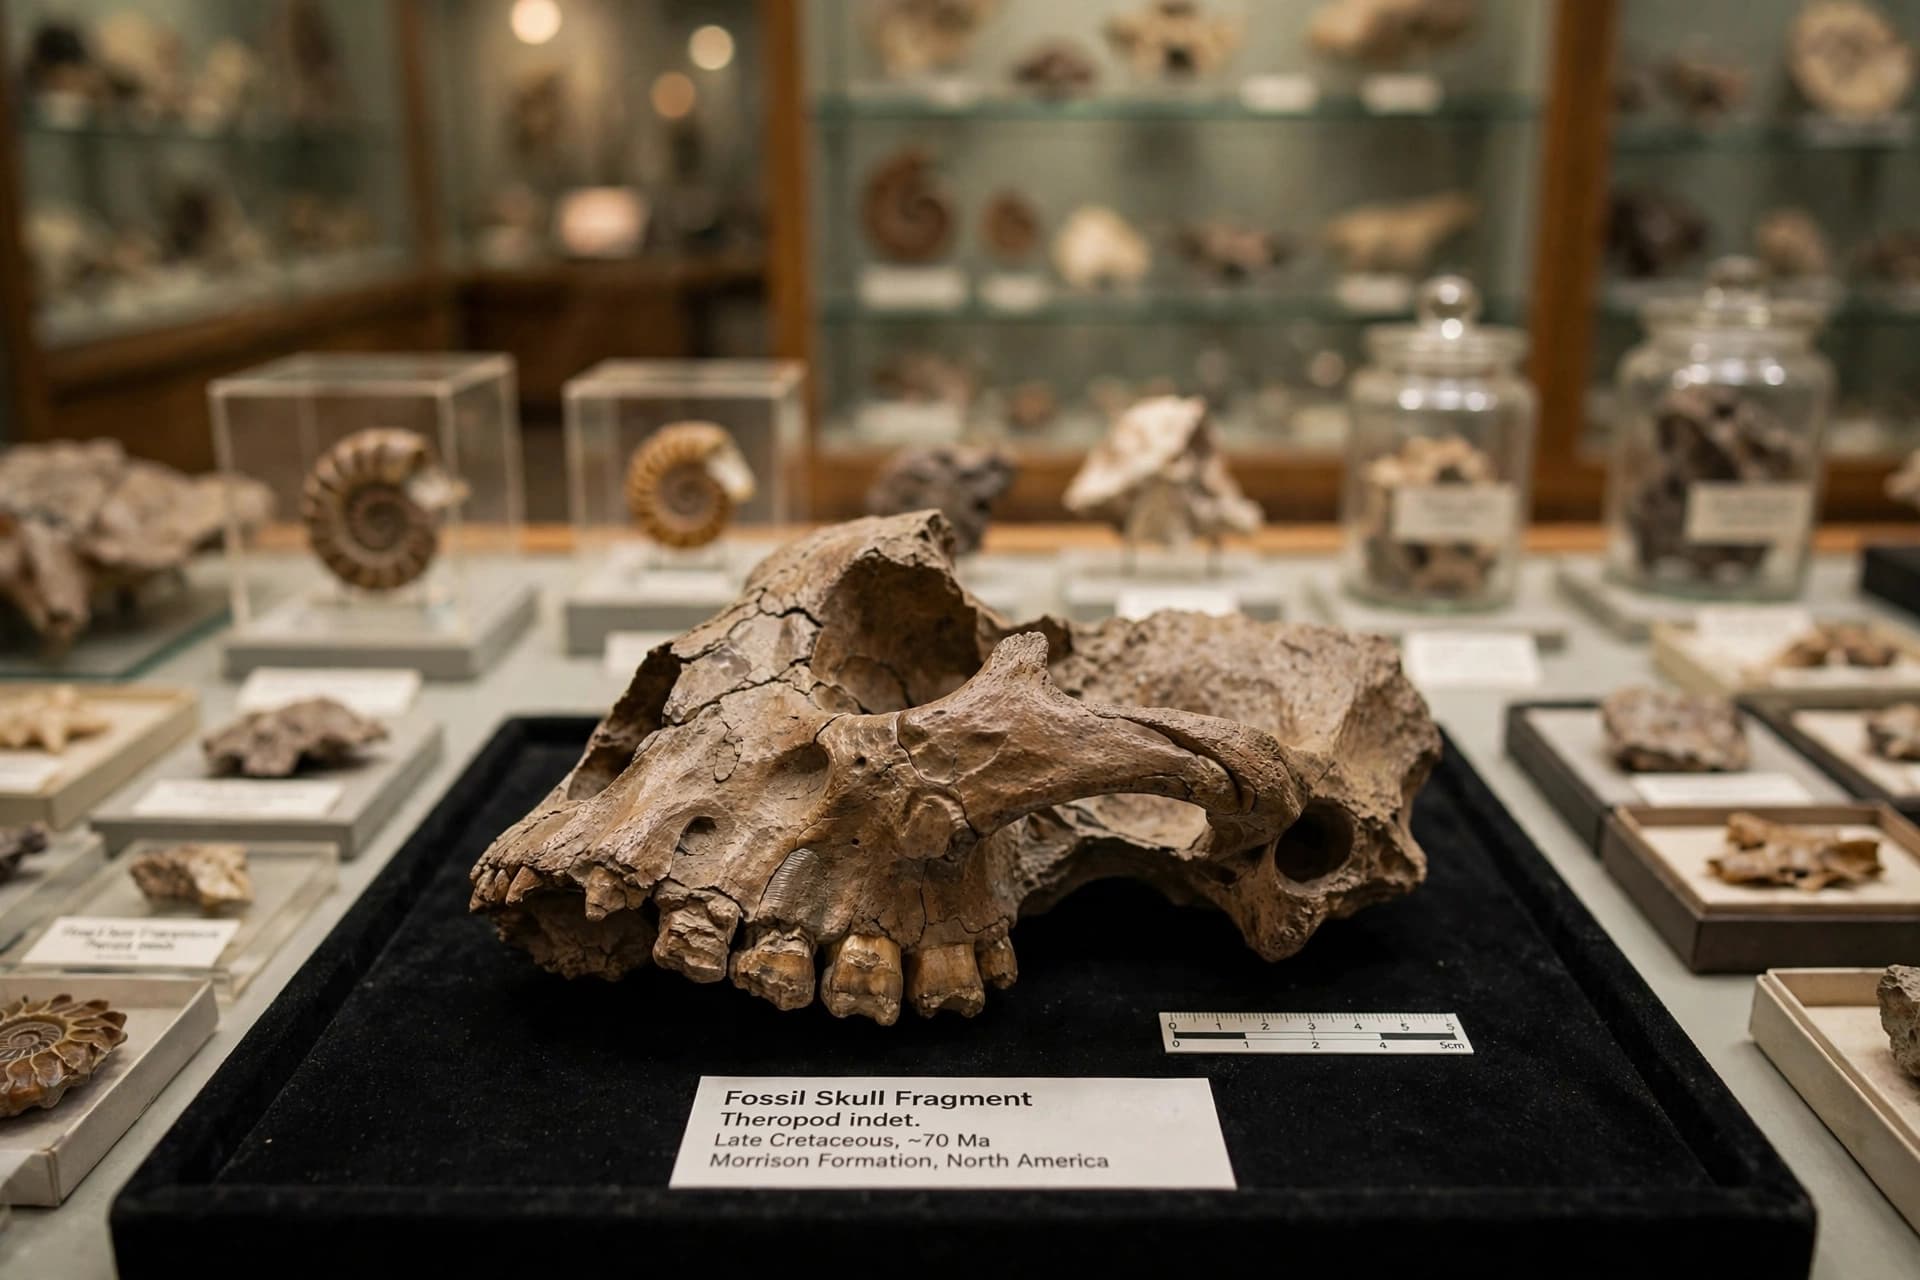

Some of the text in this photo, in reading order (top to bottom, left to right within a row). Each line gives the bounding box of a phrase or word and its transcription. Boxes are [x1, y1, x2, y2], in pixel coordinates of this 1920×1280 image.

[1168, 1022, 1455, 1031] 0 1 2 3 4 5 5
[1172, 1040, 1180, 1048] 0
[1311, 1041, 1320, 1049] 2
[1379, 1041, 1387, 1049] 4
[1439, 1041, 1465, 1049] 5cm
[724, 1090, 1033, 1110] Fossil Skull Fragment
[719, 1111, 921, 1131] Theropod indet.
[714, 1132, 991, 1150] Late Cretaceous, ~70 Ma
[710, 1153, 1110, 1169] Morrison Formation, North America
